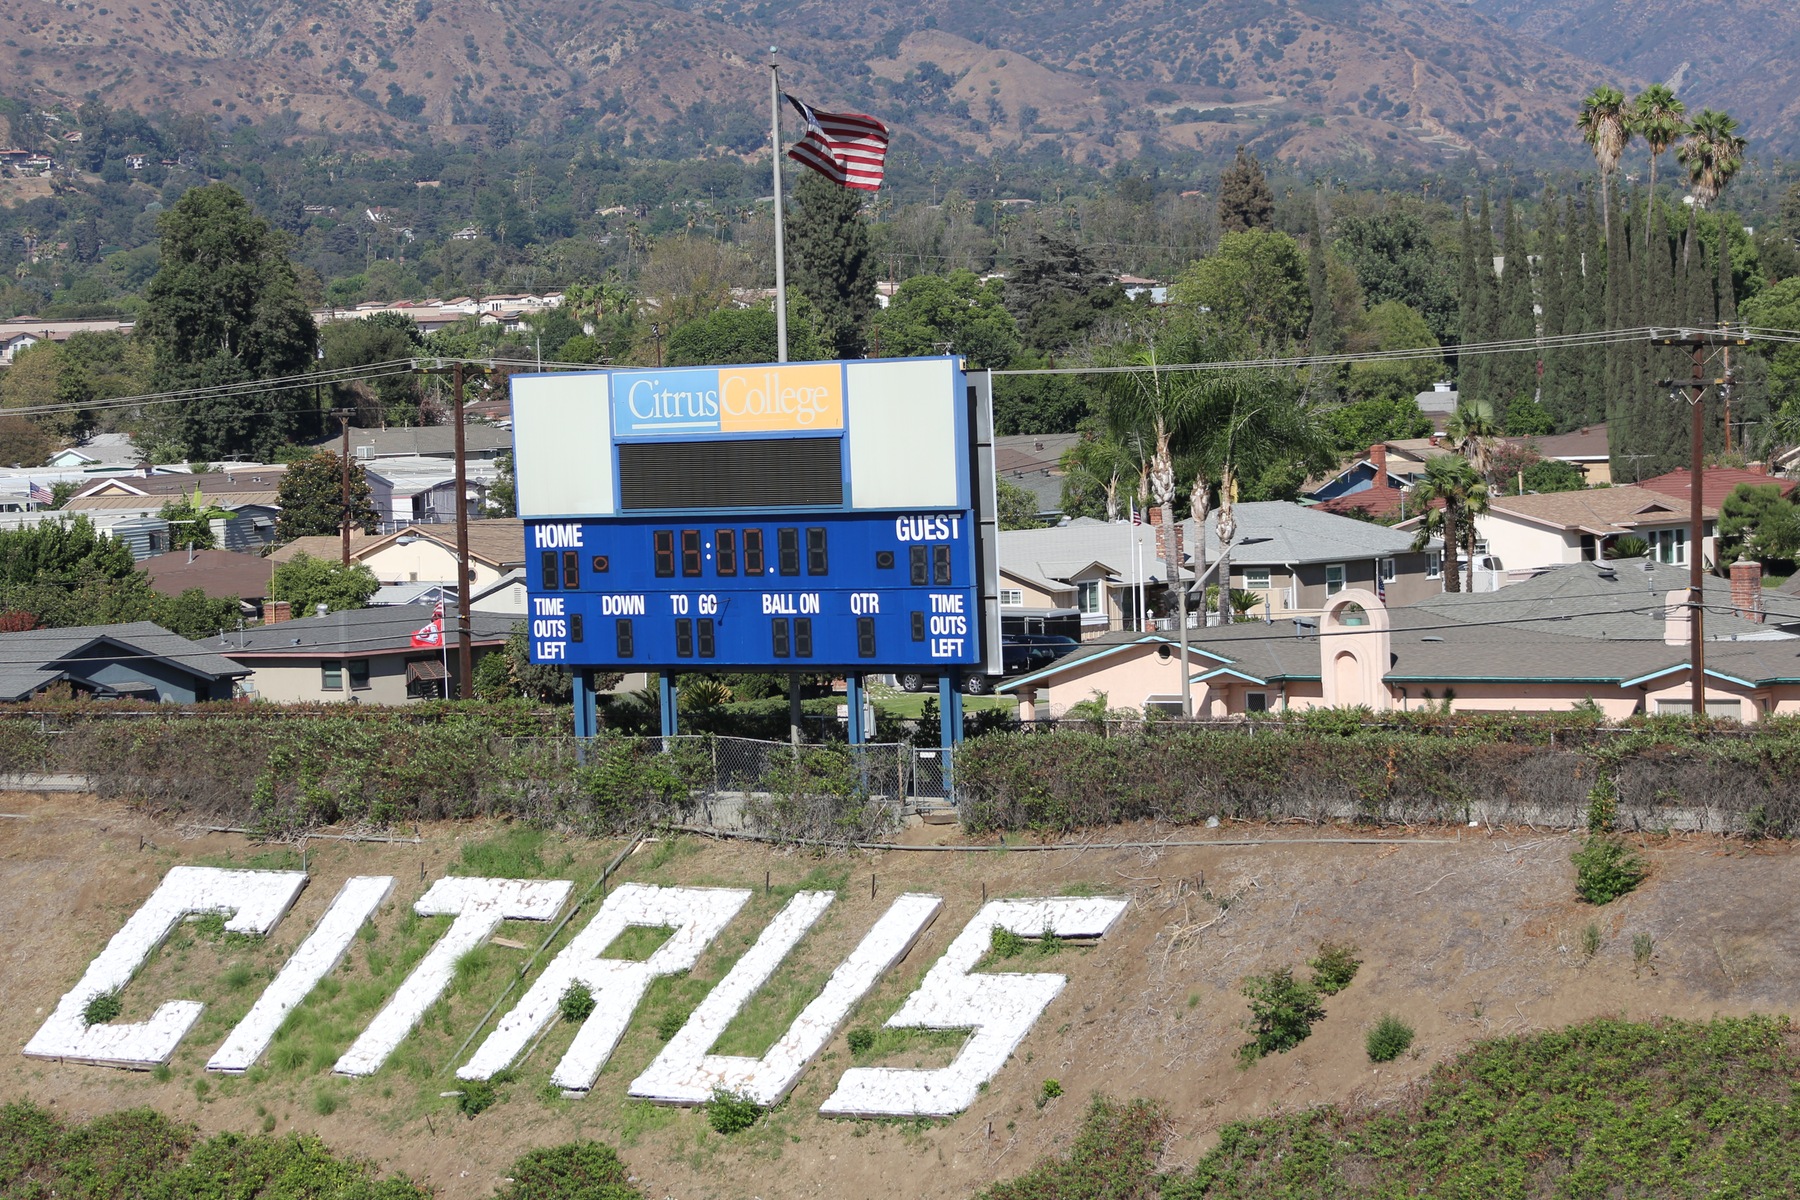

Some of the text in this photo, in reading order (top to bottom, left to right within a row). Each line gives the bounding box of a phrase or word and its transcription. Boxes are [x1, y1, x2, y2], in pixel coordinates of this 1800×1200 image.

[628, 372, 829, 425] Citrus College
[534, 523, 583, 548] HOME
[895, 513, 961, 541] GUEST
[533, 598, 565, 616] TIME
[602, 595, 645, 615] DOWN
[670, 594, 718, 615] TO GO
[762, 593, 820, 614] BALL ON
[850, 593, 880, 615] QTR
[929, 593, 964, 613] TIME
[533, 619, 567, 638] OUTS
[930, 616, 967, 635] OUTS
[537, 641, 567, 660] LEFT
[931, 638, 964, 658] LEFT
[23, 865, 1130, 1118] CITRUS
